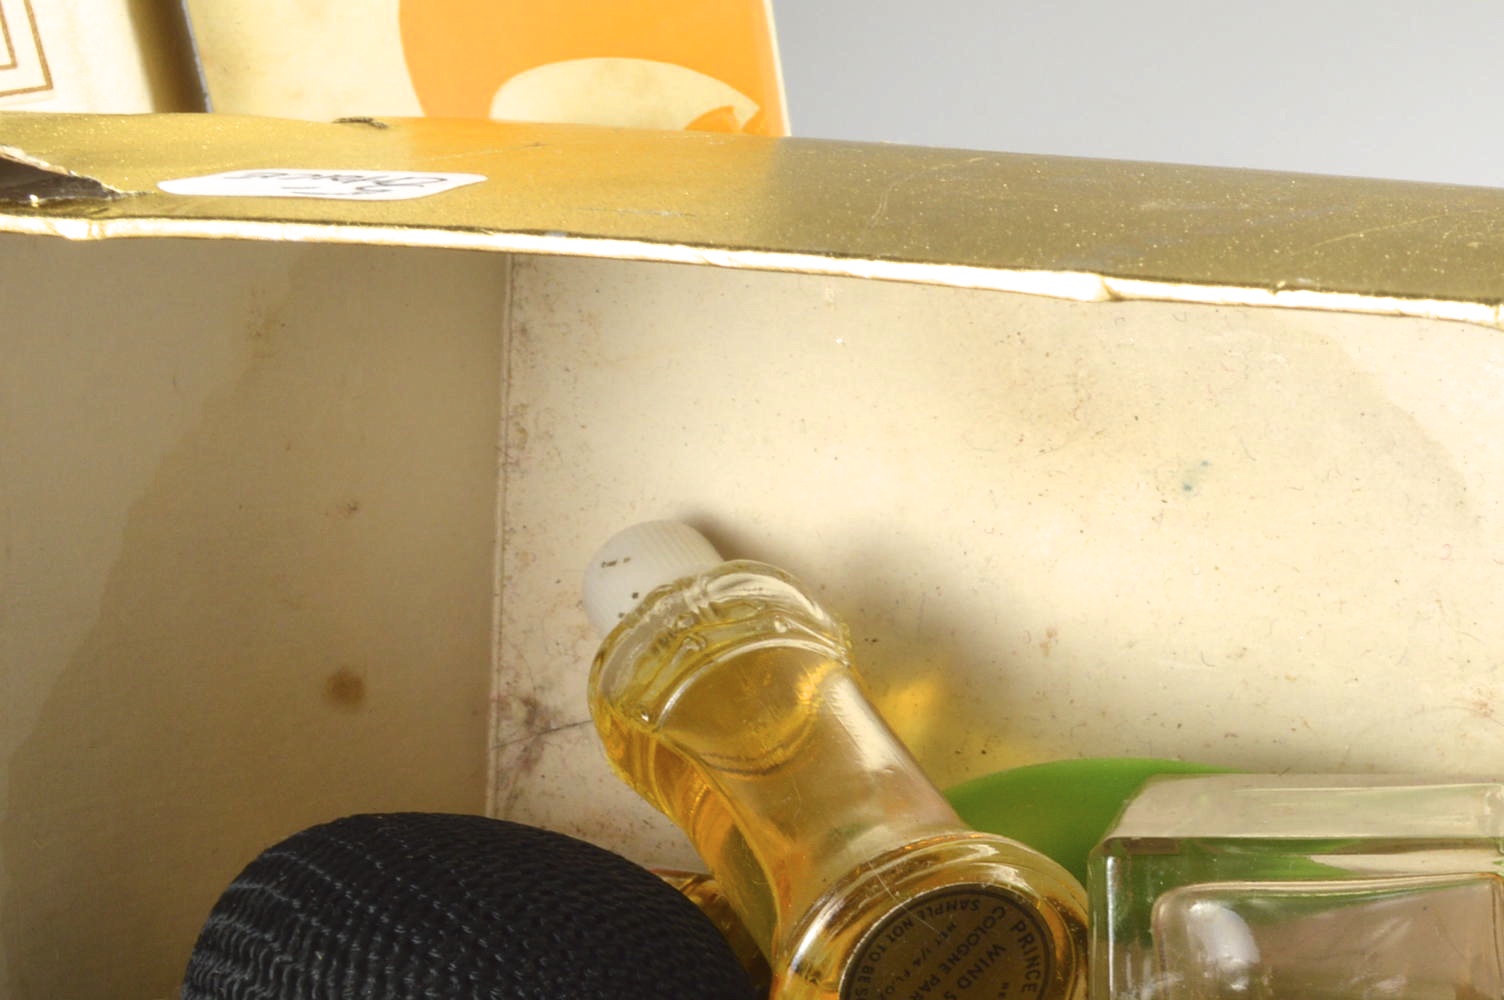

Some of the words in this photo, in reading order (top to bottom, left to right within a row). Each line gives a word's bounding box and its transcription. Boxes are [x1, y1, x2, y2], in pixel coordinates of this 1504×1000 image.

[917, 899, 980, 919] SAMPLE
[886, 919, 914, 943] NOT
[939, 906, 1006, 975] COLOGNE
[868, 944, 886, 962] TO
[1010, 920, 1041, 993] PRINCE
[858, 965, 875, 984] BE
[957, 944, 1007, 989] WIND
